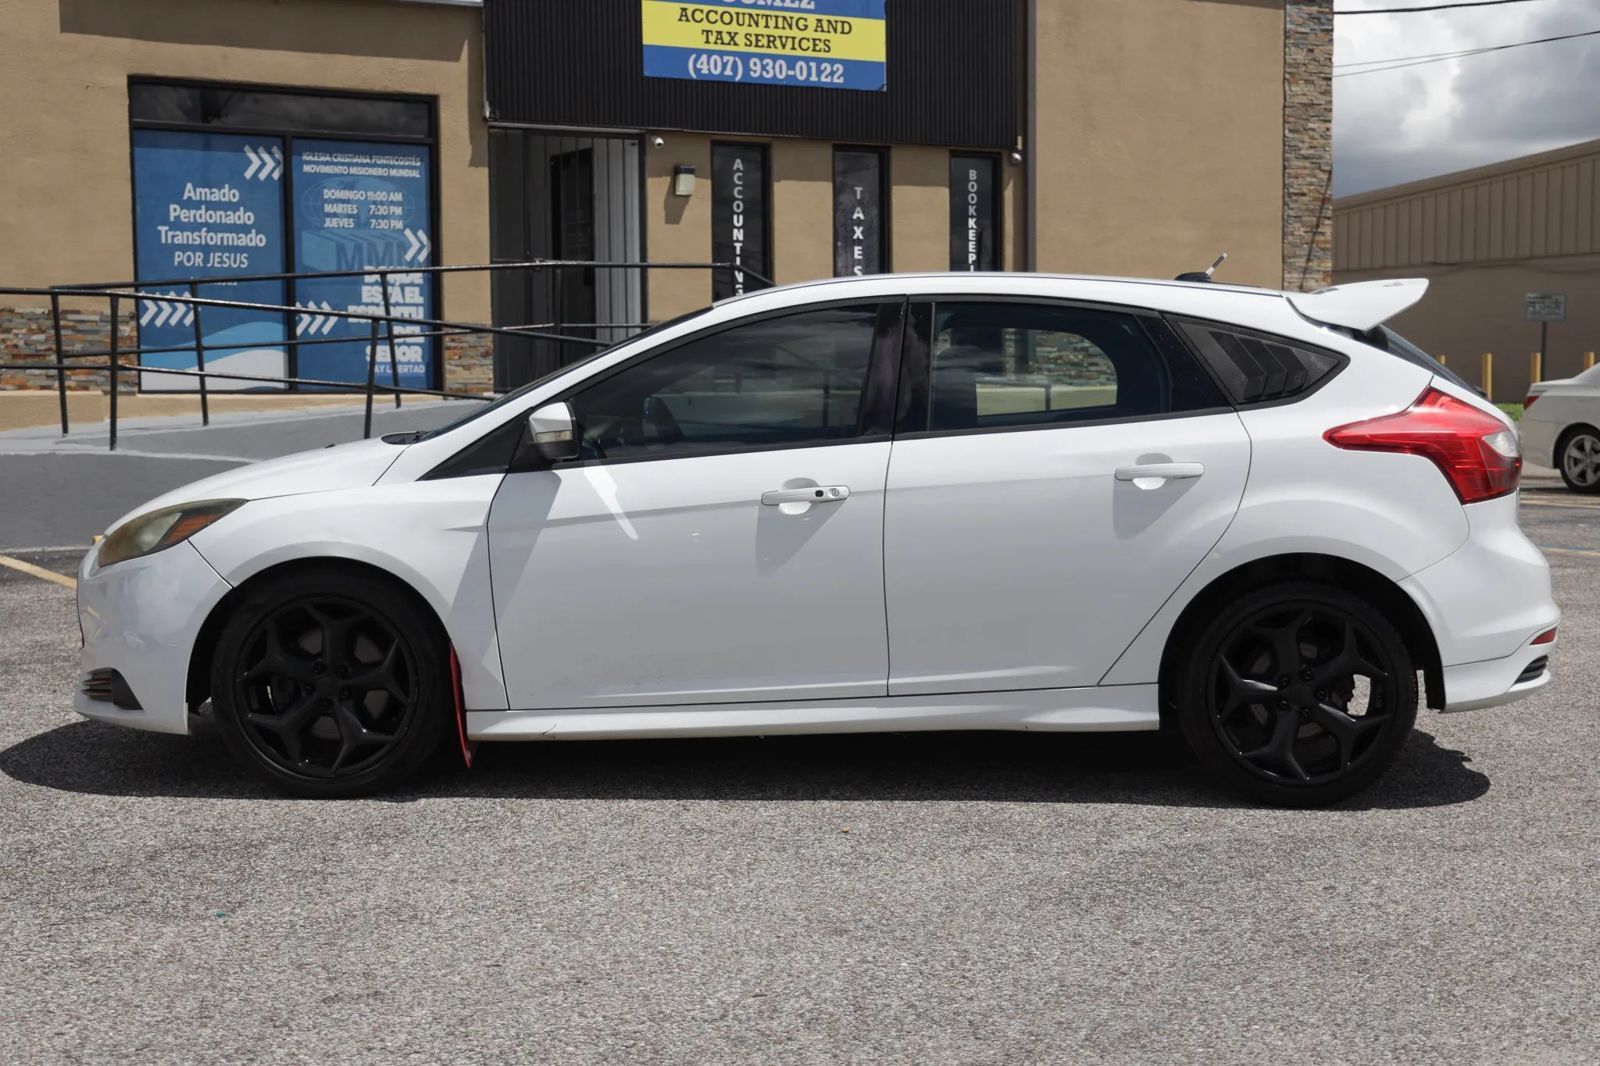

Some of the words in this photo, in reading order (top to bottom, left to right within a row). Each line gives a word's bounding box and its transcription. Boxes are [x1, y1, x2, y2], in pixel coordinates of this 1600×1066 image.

[678, 7, 808, 32] ACCOUNTING
[813, 18, 853, 35] AND
[701, 29, 740, 47] TAX
[744, 33, 832, 53] SERVICES
[688, 53, 743, 82] (407)
[749, 58, 845, 83] 930-0122
[302, 152, 331, 162] IGLESIA
[332, 153, 371, 164] CRISTIANA
[303, 164, 349, 174] MOVIMIENTO
[349, 166, 389, 176] MISIONERO
[389, 168, 421, 178] MUNDIAL
[183, 182, 240, 203] Amado
[323, 188, 366, 201] DOMINGO
[366, 190, 388, 202] 11:00
[388, 191, 403, 202] AM
[169, 203, 255, 225] Perdonado
[324, 203, 358, 215] MARTES
[369, 204, 388, 216] 7:30
[389, 204, 403, 216] PM
[323, 217, 355, 229] JUEVES
[370, 218, 389, 230] 7:30
[390, 218, 404, 231] PM
[852, 187, 865, 277] TAXES
[156, 225, 267, 248] Transformado
[174, 251, 204, 268] POR
[206, 252, 249, 269] JESUS
[386, 363, 426, 374] LERTAD
